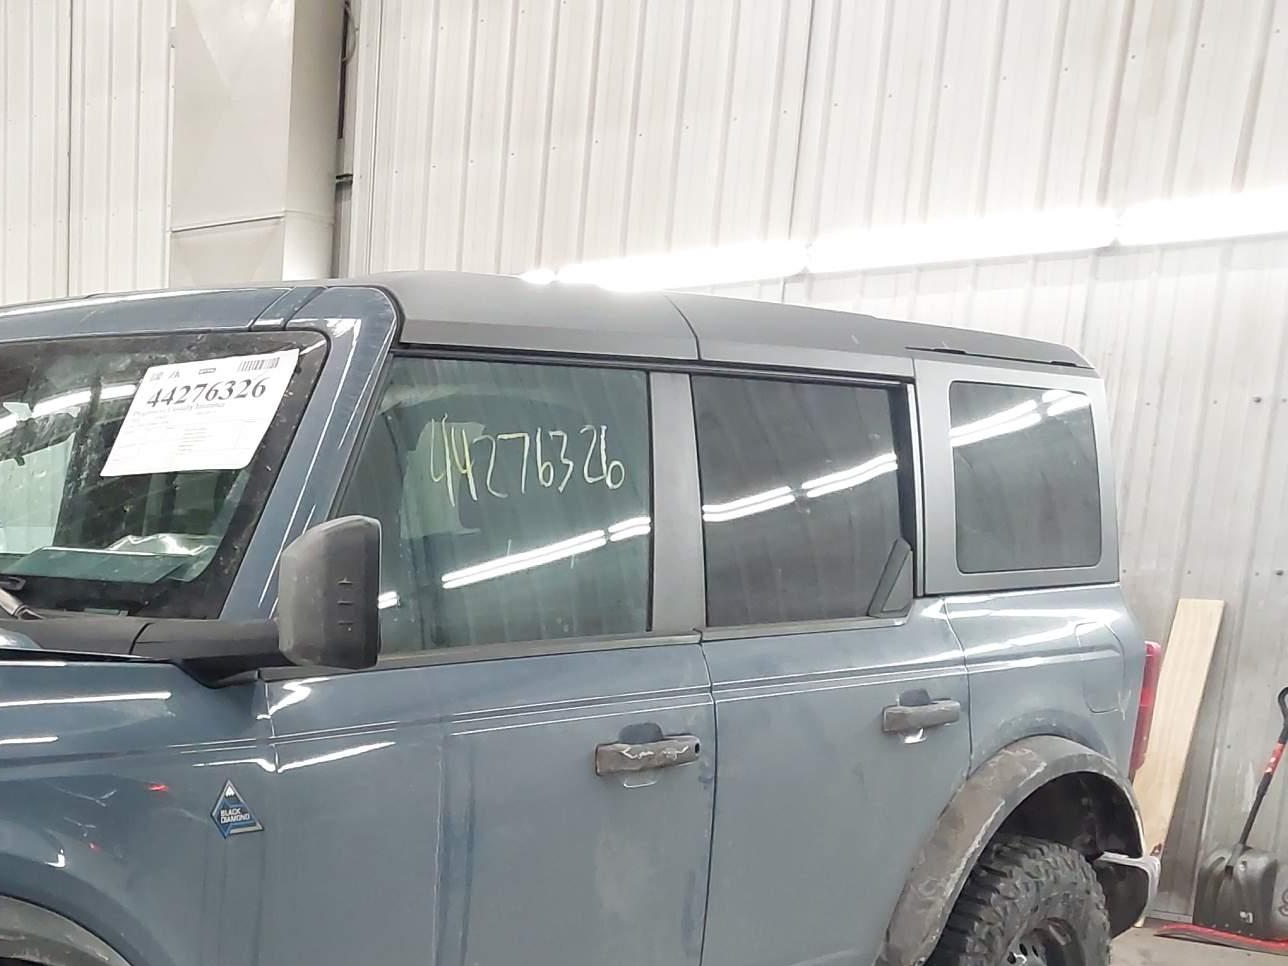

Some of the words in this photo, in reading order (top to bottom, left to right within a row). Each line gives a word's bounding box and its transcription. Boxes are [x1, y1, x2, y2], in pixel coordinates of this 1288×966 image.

[146, 377, 269, 409] 44276326
[430, 412, 626, 507] 44276326
[220, 807, 241, 817] BLACK
[220, 813, 250, 824] DIAMOND
